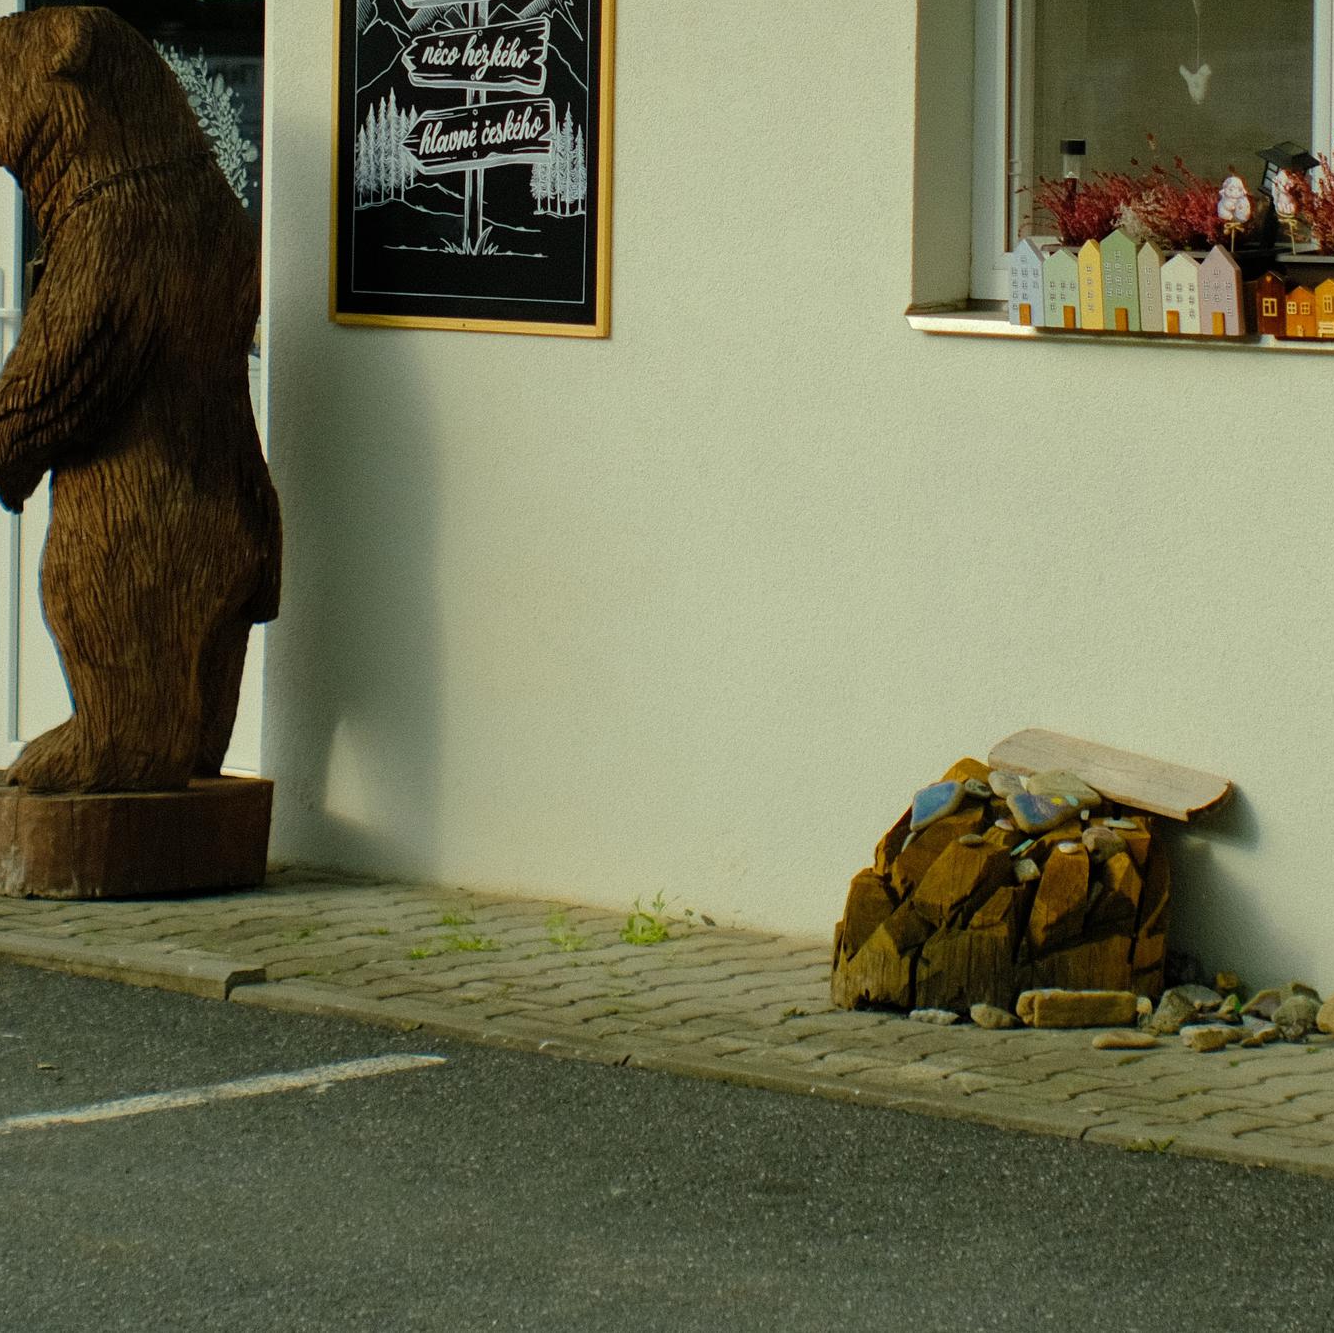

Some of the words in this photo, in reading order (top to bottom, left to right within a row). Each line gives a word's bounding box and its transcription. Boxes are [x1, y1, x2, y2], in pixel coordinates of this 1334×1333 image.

[421, 40, 461, 66] něco
[462, 34, 530, 80] hezkého
[419, 120, 478, 155] hlavně
[481, 106, 544, 145] českého
